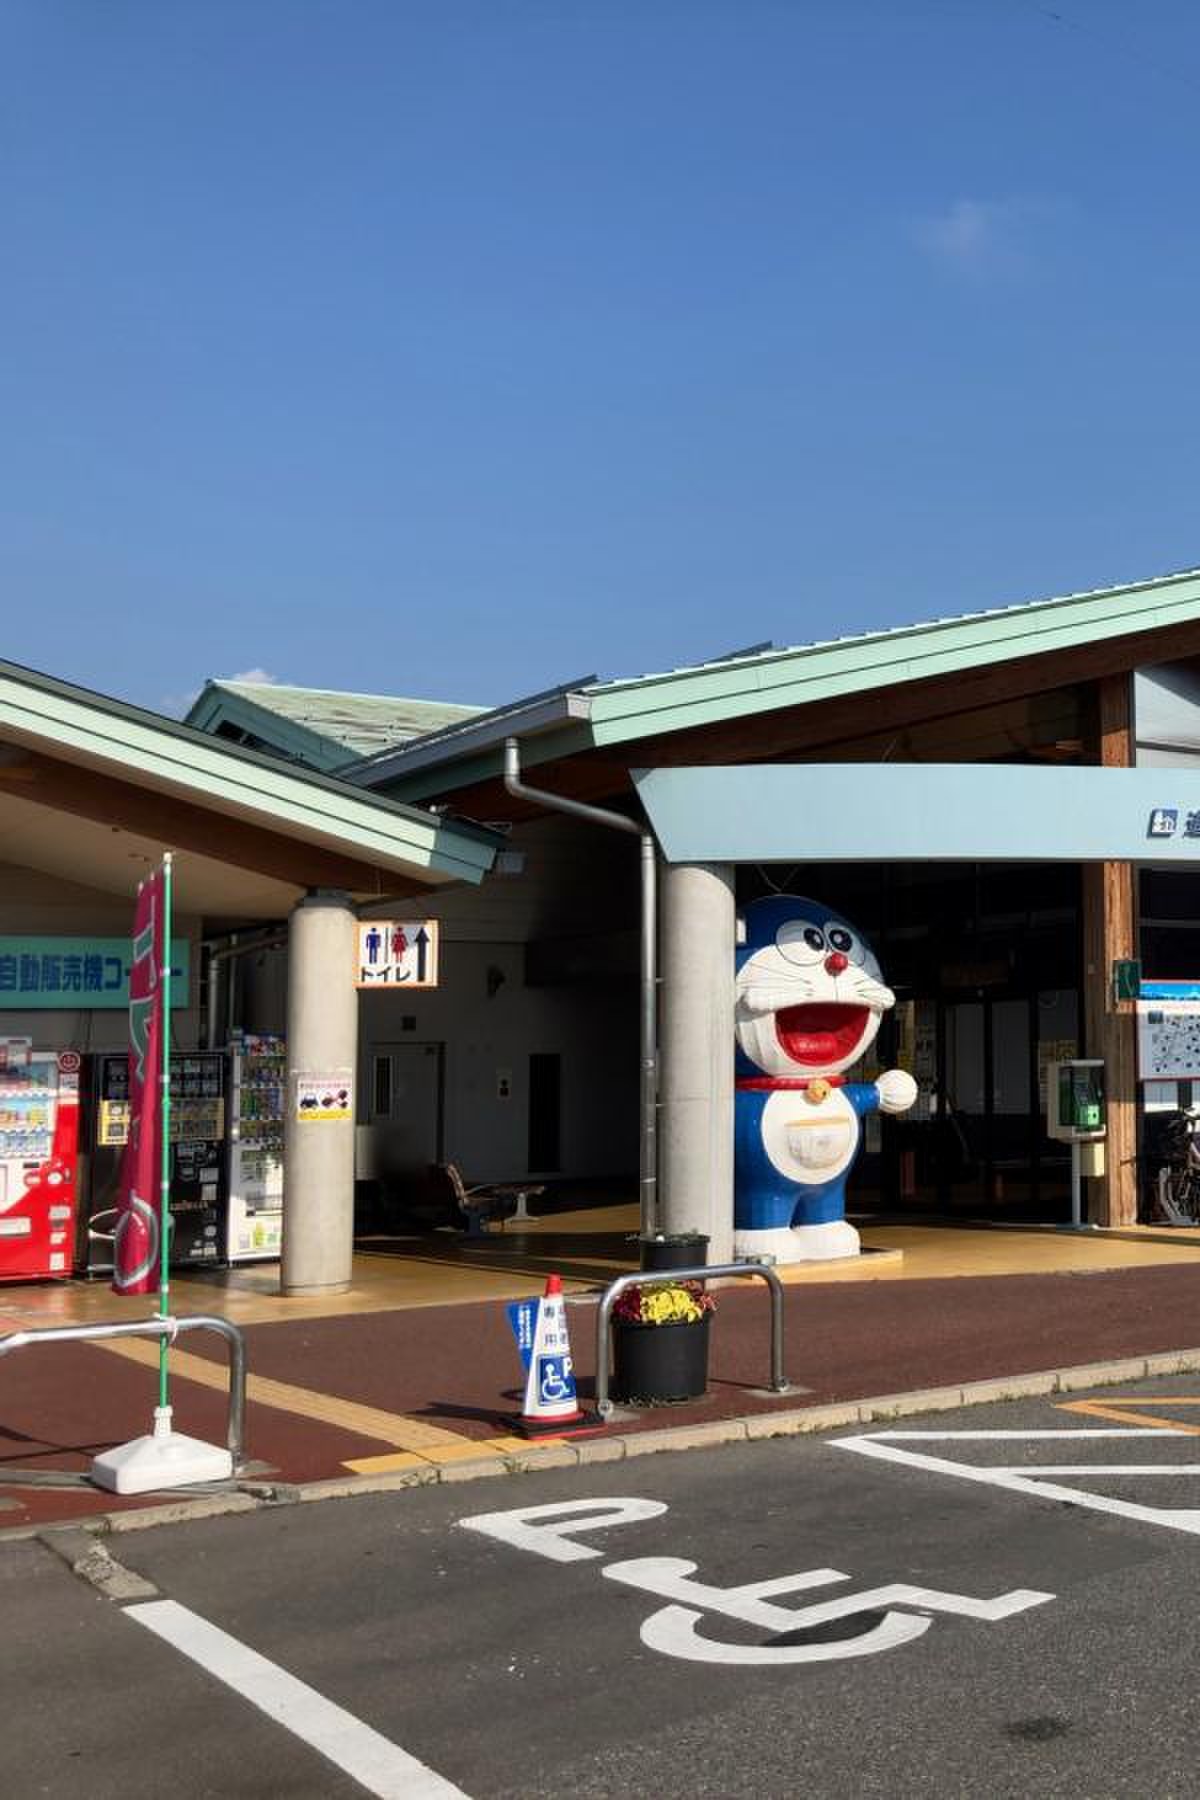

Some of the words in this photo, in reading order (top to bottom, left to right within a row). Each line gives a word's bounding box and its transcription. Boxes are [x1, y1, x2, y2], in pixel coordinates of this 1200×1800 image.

[360, 966, 411, 983] トイレ
[562, 1357, 573, 1377] P
[458, 1497, 670, 1562] P
